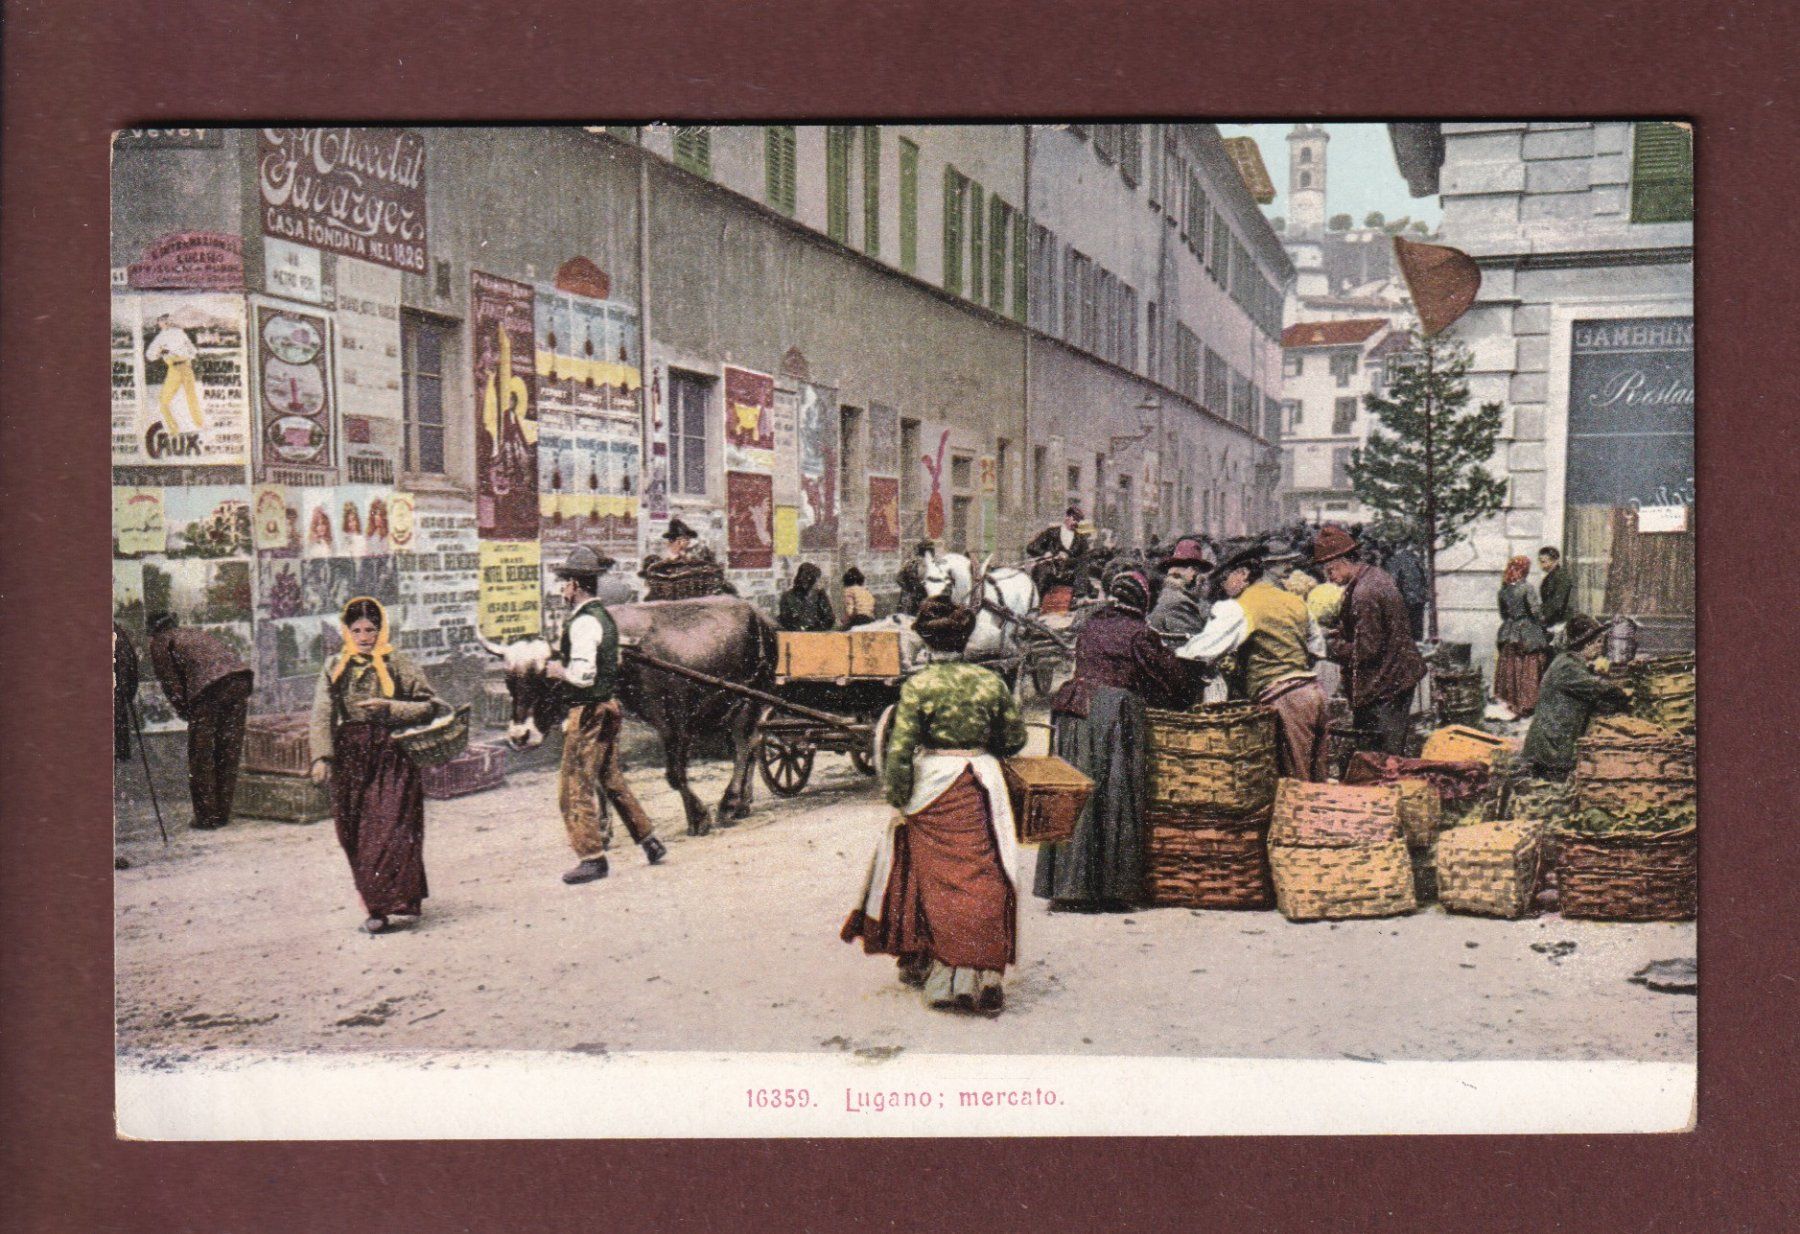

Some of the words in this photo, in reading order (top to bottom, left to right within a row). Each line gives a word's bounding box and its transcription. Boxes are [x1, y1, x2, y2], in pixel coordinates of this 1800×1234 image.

[267, 207, 305, 239] CASA
[307, 217, 366, 255] FONDATA
[369, 240, 392, 262] NEL
